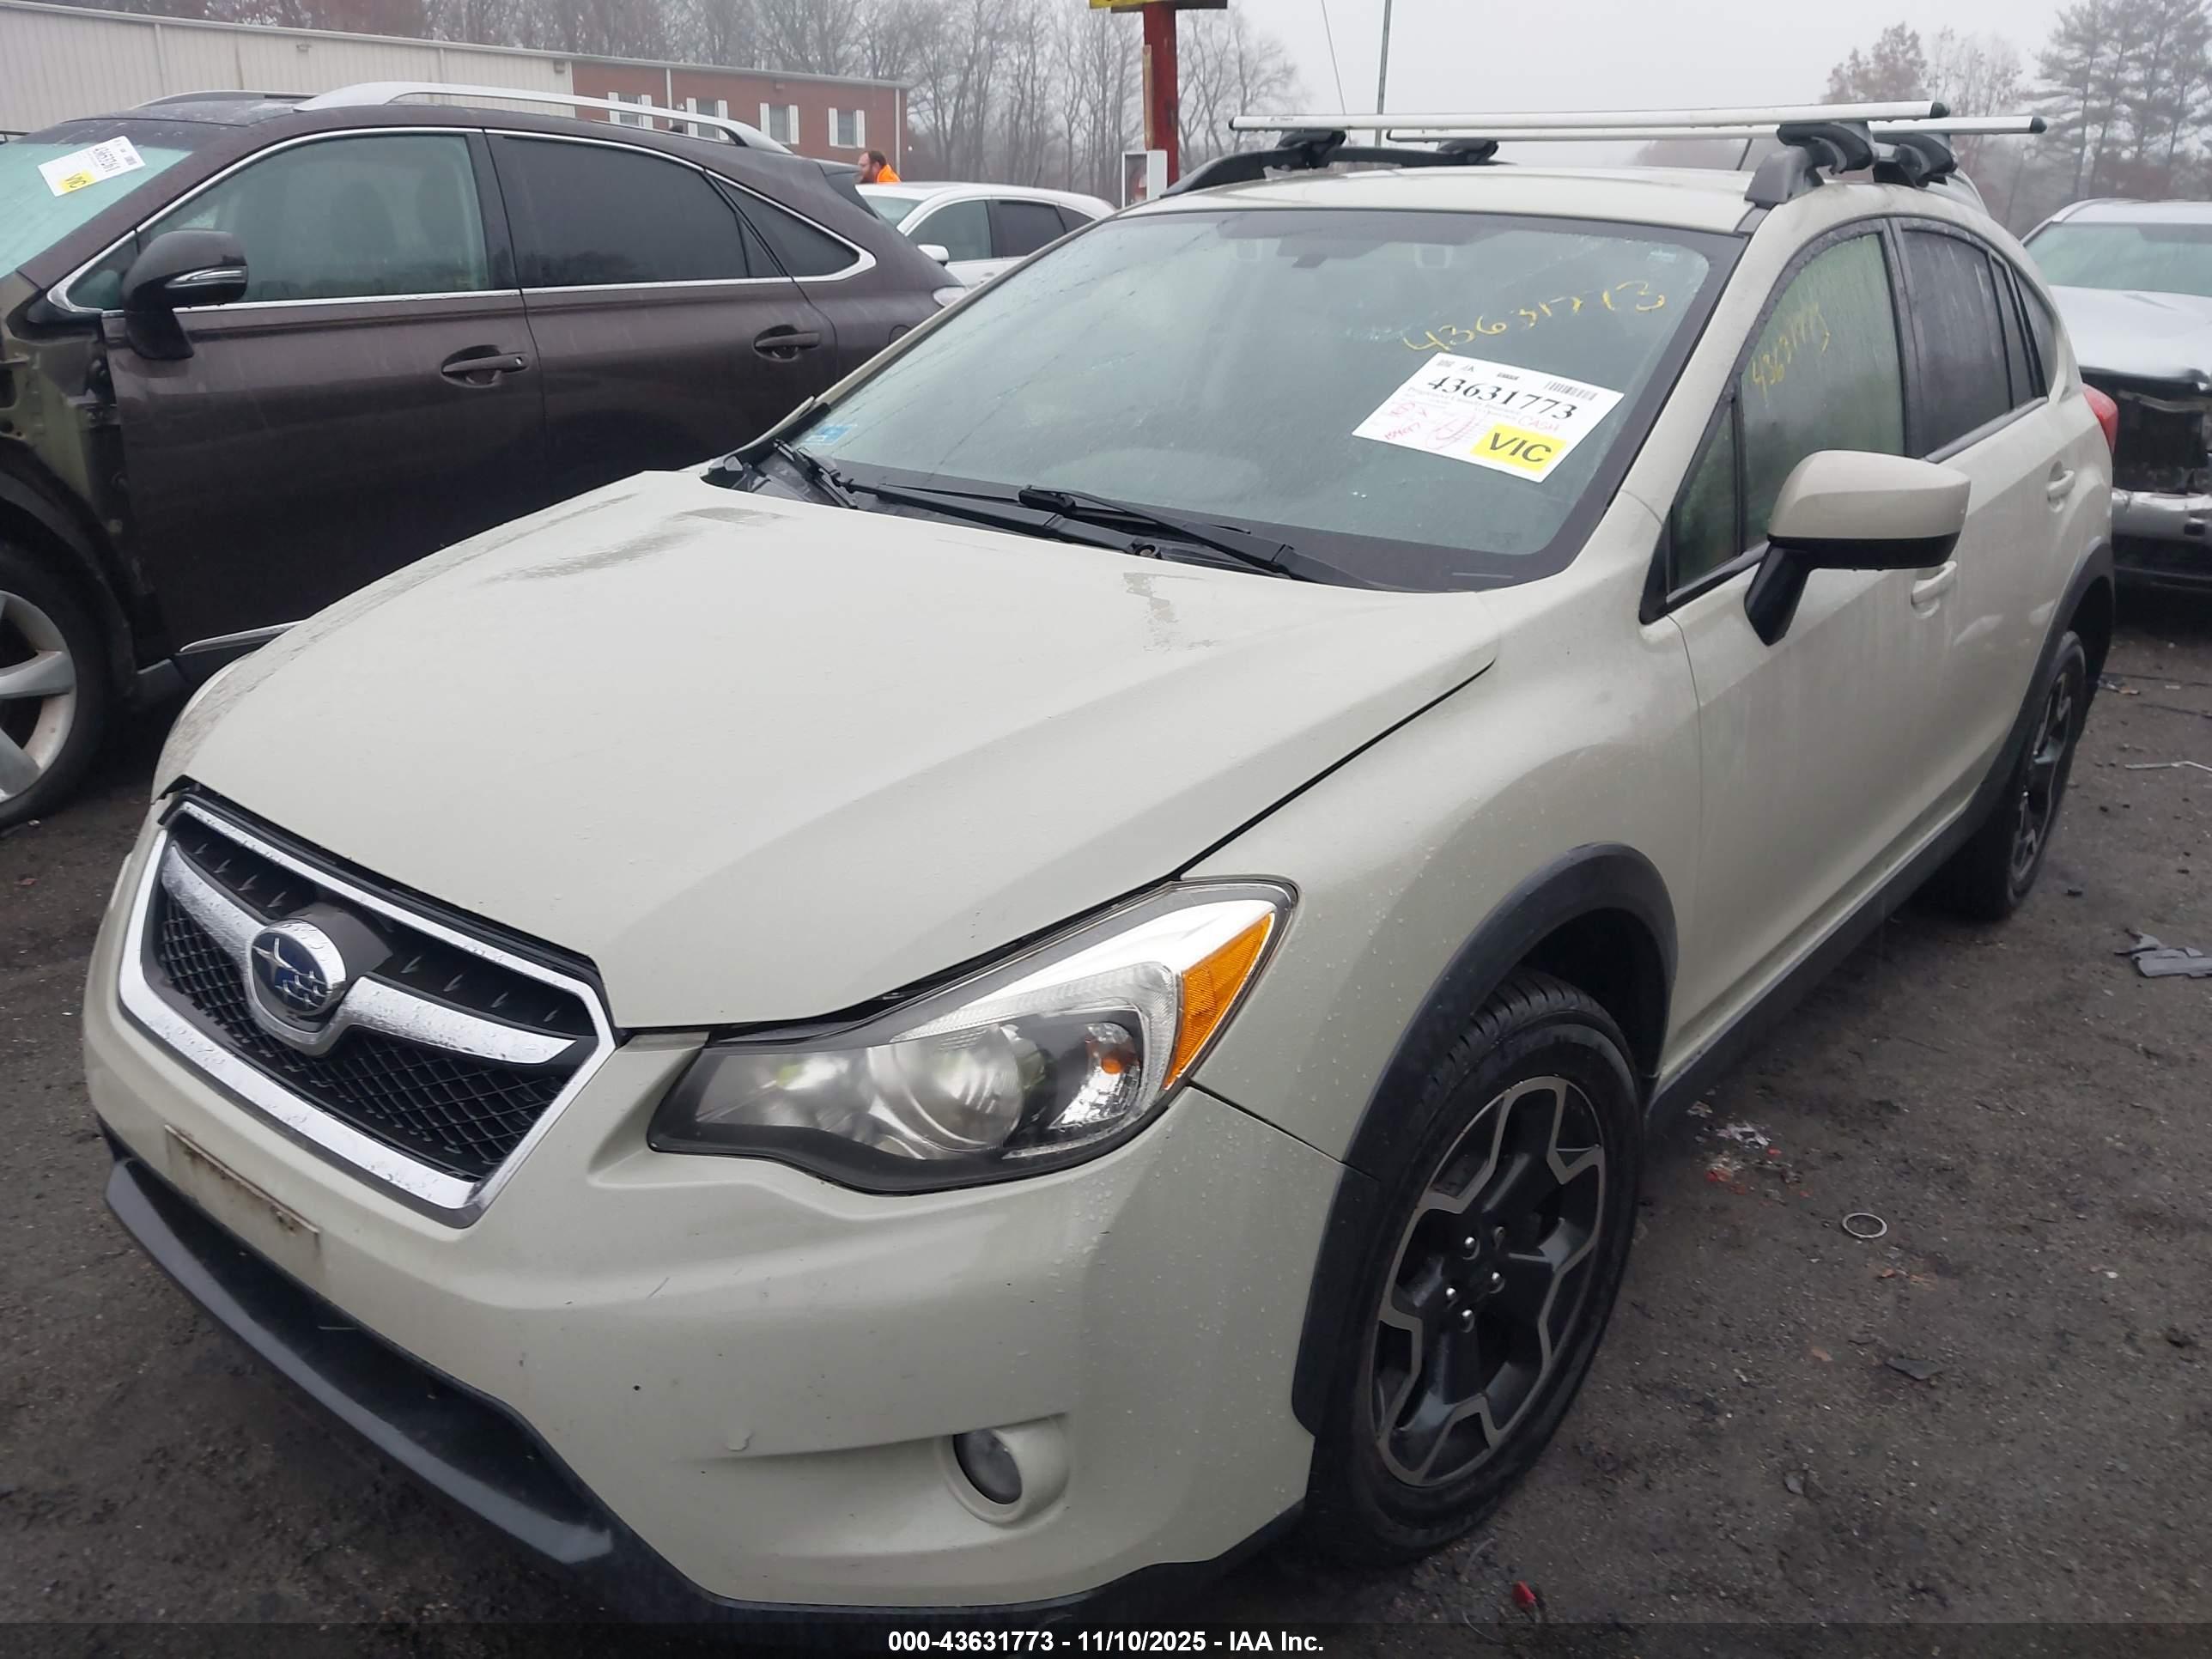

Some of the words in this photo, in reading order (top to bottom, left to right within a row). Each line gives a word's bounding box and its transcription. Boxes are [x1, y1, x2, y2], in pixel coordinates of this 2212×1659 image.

[64, 173, 87, 189] VIC
[1426, 375, 1578, 420] 43631773
[1488, 432, 1553, 463] VIC
